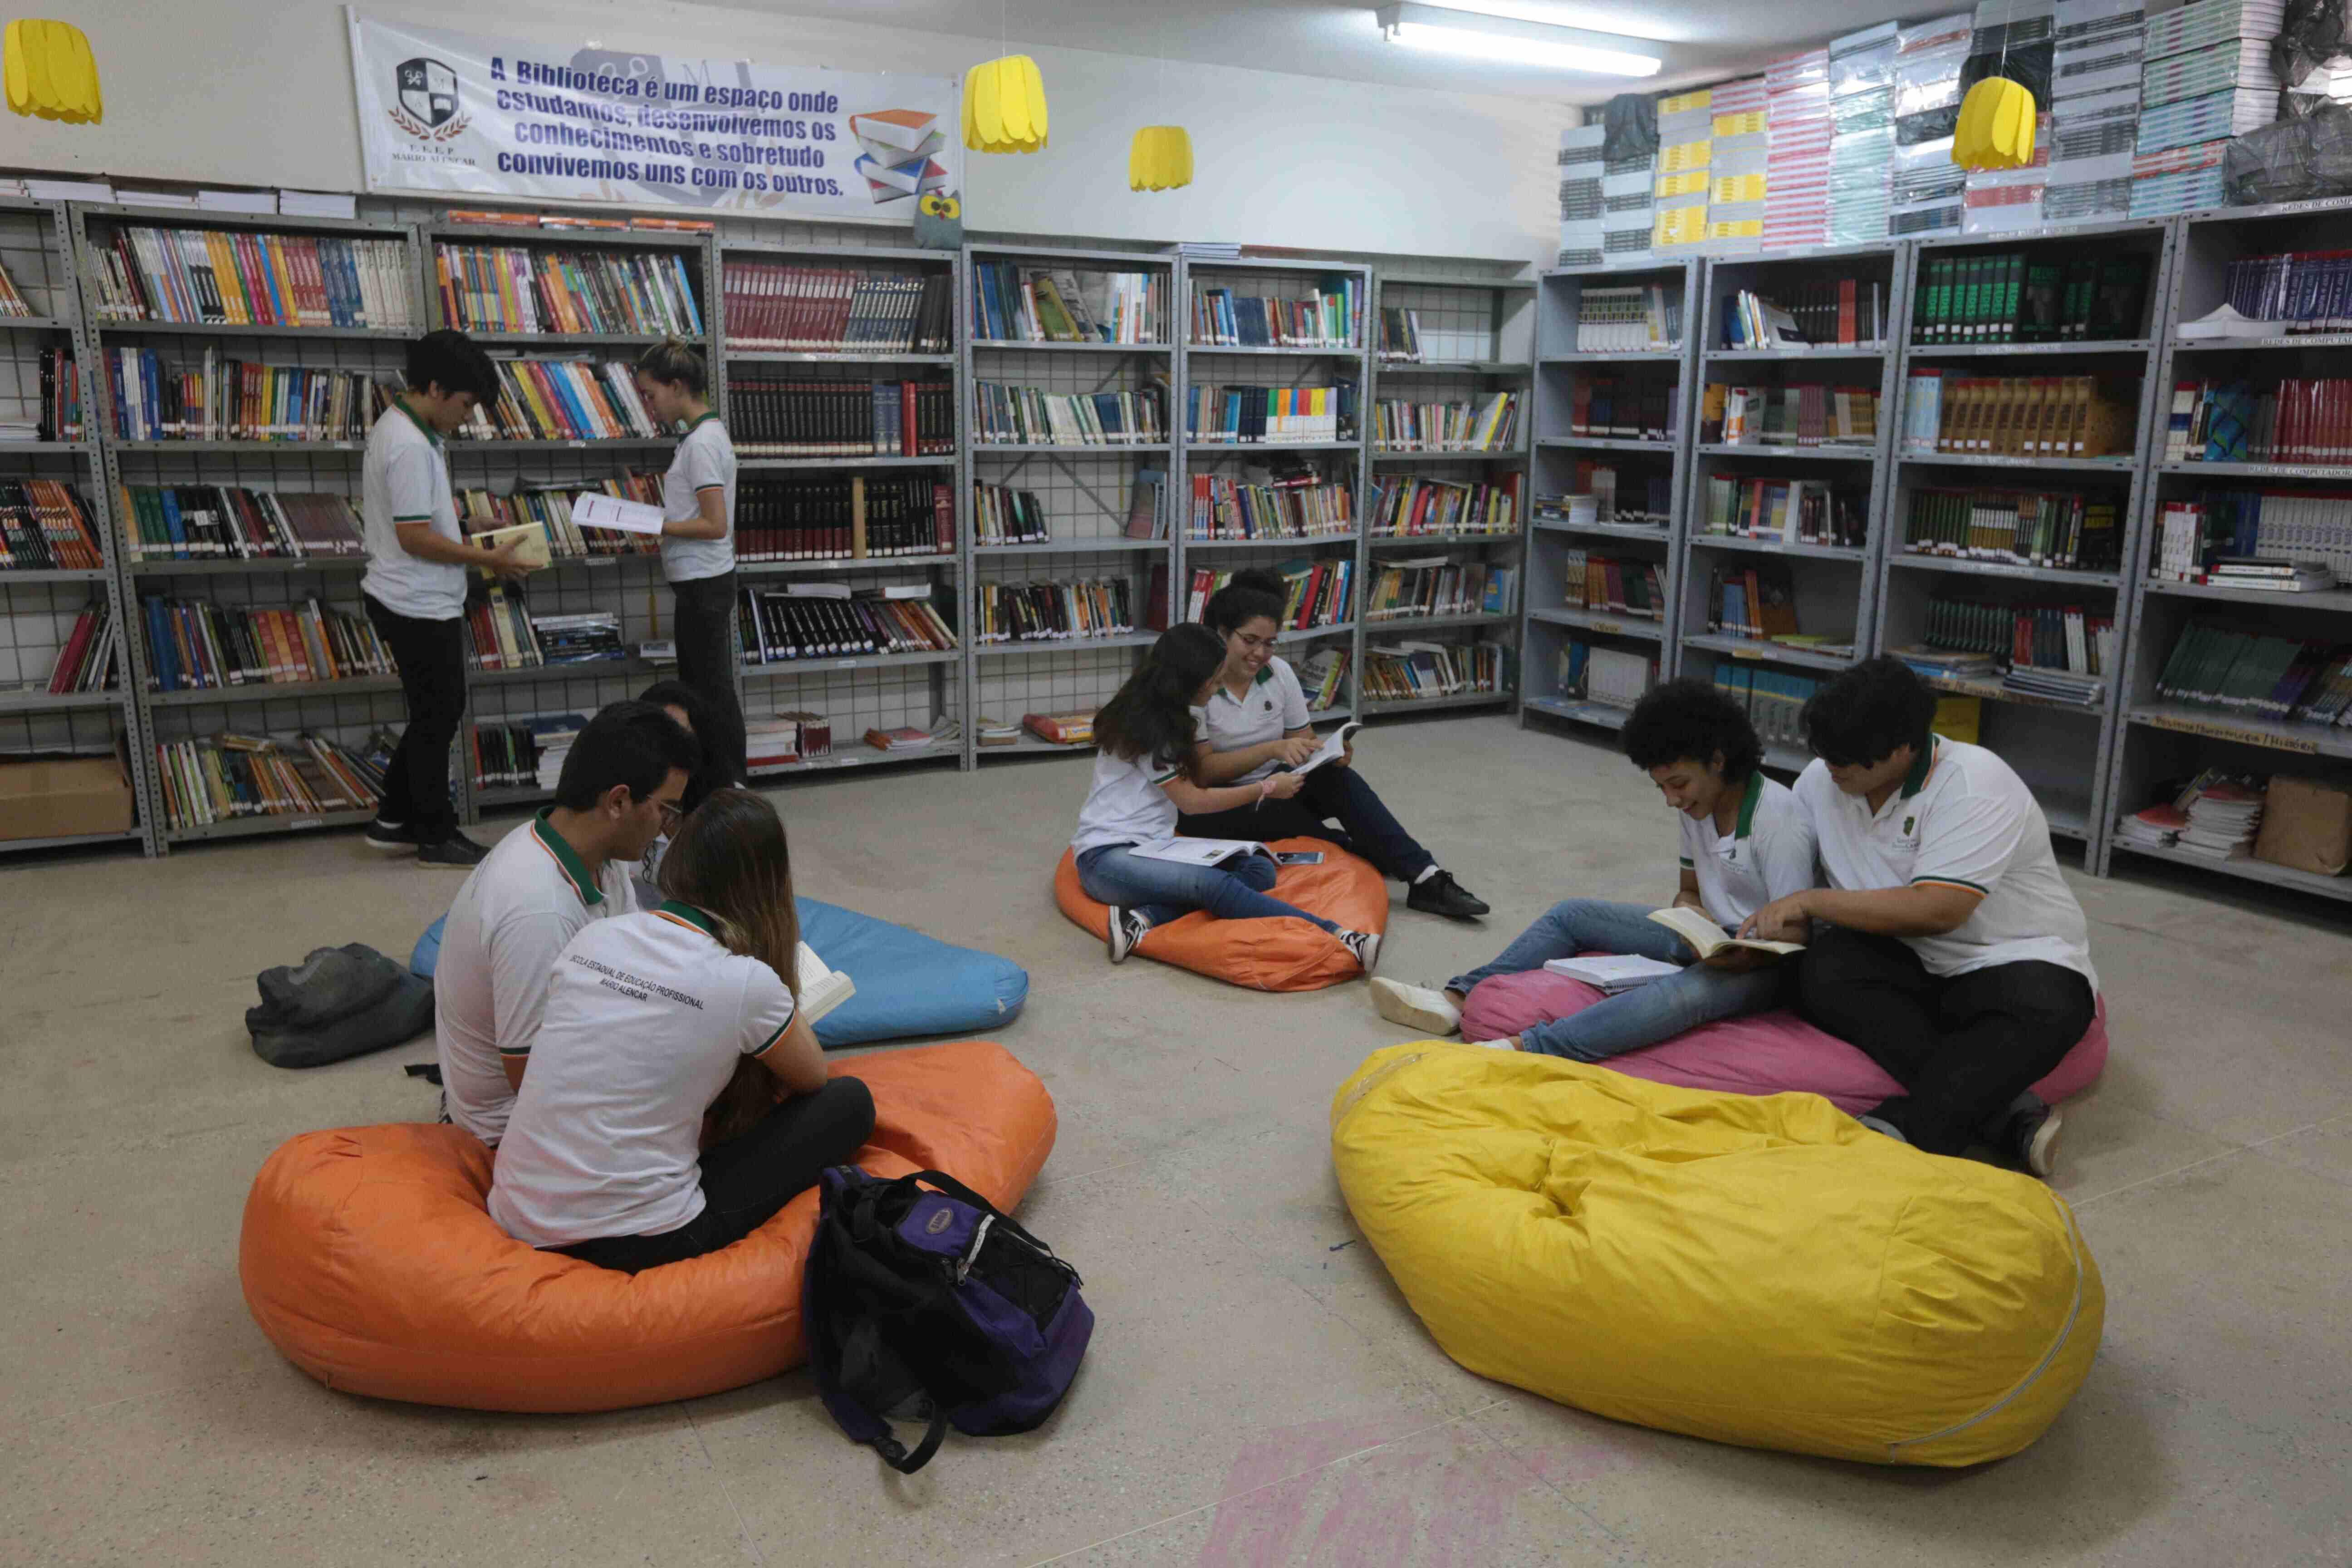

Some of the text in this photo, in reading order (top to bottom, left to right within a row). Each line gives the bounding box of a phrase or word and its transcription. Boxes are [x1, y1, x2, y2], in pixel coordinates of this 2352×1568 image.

[491, 57, 838, 113] A Biblioteca é um espaço onde
[498, 89, 836, 141] estudamos, desenvolvemos os
[515, 122, 824, 168] conhecimentos e sobretudo
[498, 152, 843, 196] convivemos uns com os outros.
[587, 960, 616, 978] ESTADUAL
[616, 971, 626, 980] DE
[624, 974, 657, 992] EDUCAÇÃO
[656, 985, 704, 1010] PROFISSIONAL
[617, 984, 647, 1002] ALENCAR
